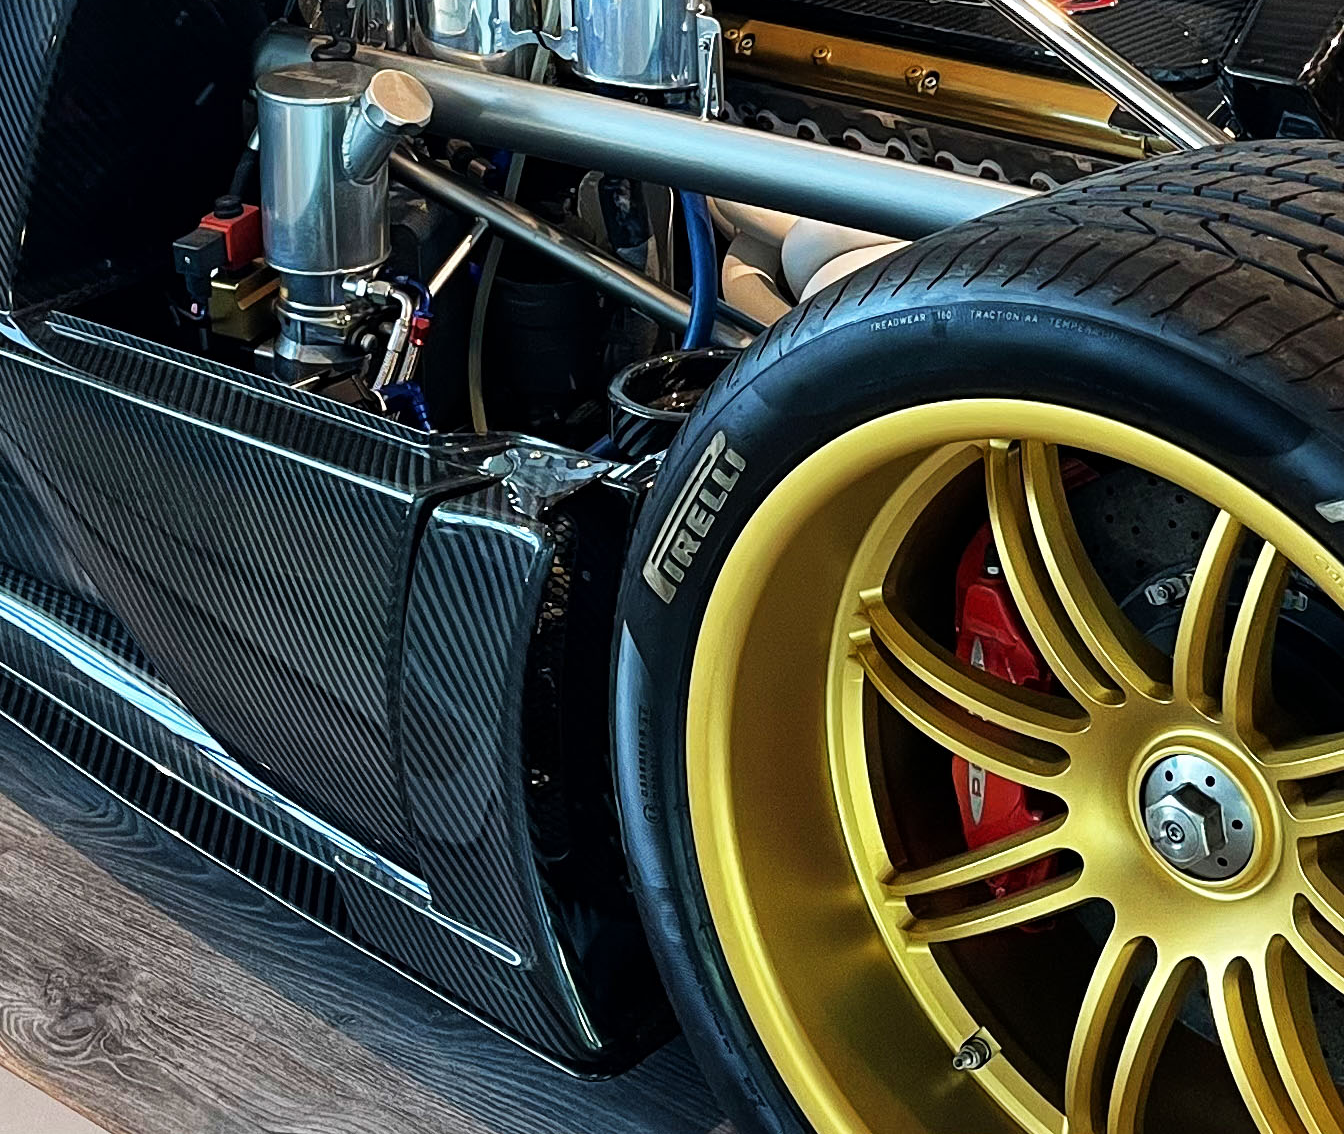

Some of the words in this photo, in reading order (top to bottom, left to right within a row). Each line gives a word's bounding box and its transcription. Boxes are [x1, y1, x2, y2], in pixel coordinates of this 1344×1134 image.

[870, 313, 927, 332] TREADWEAR
[969, 309, 1019, 322] TRACTION
[642, 430, 747, 605] PIRELLI
